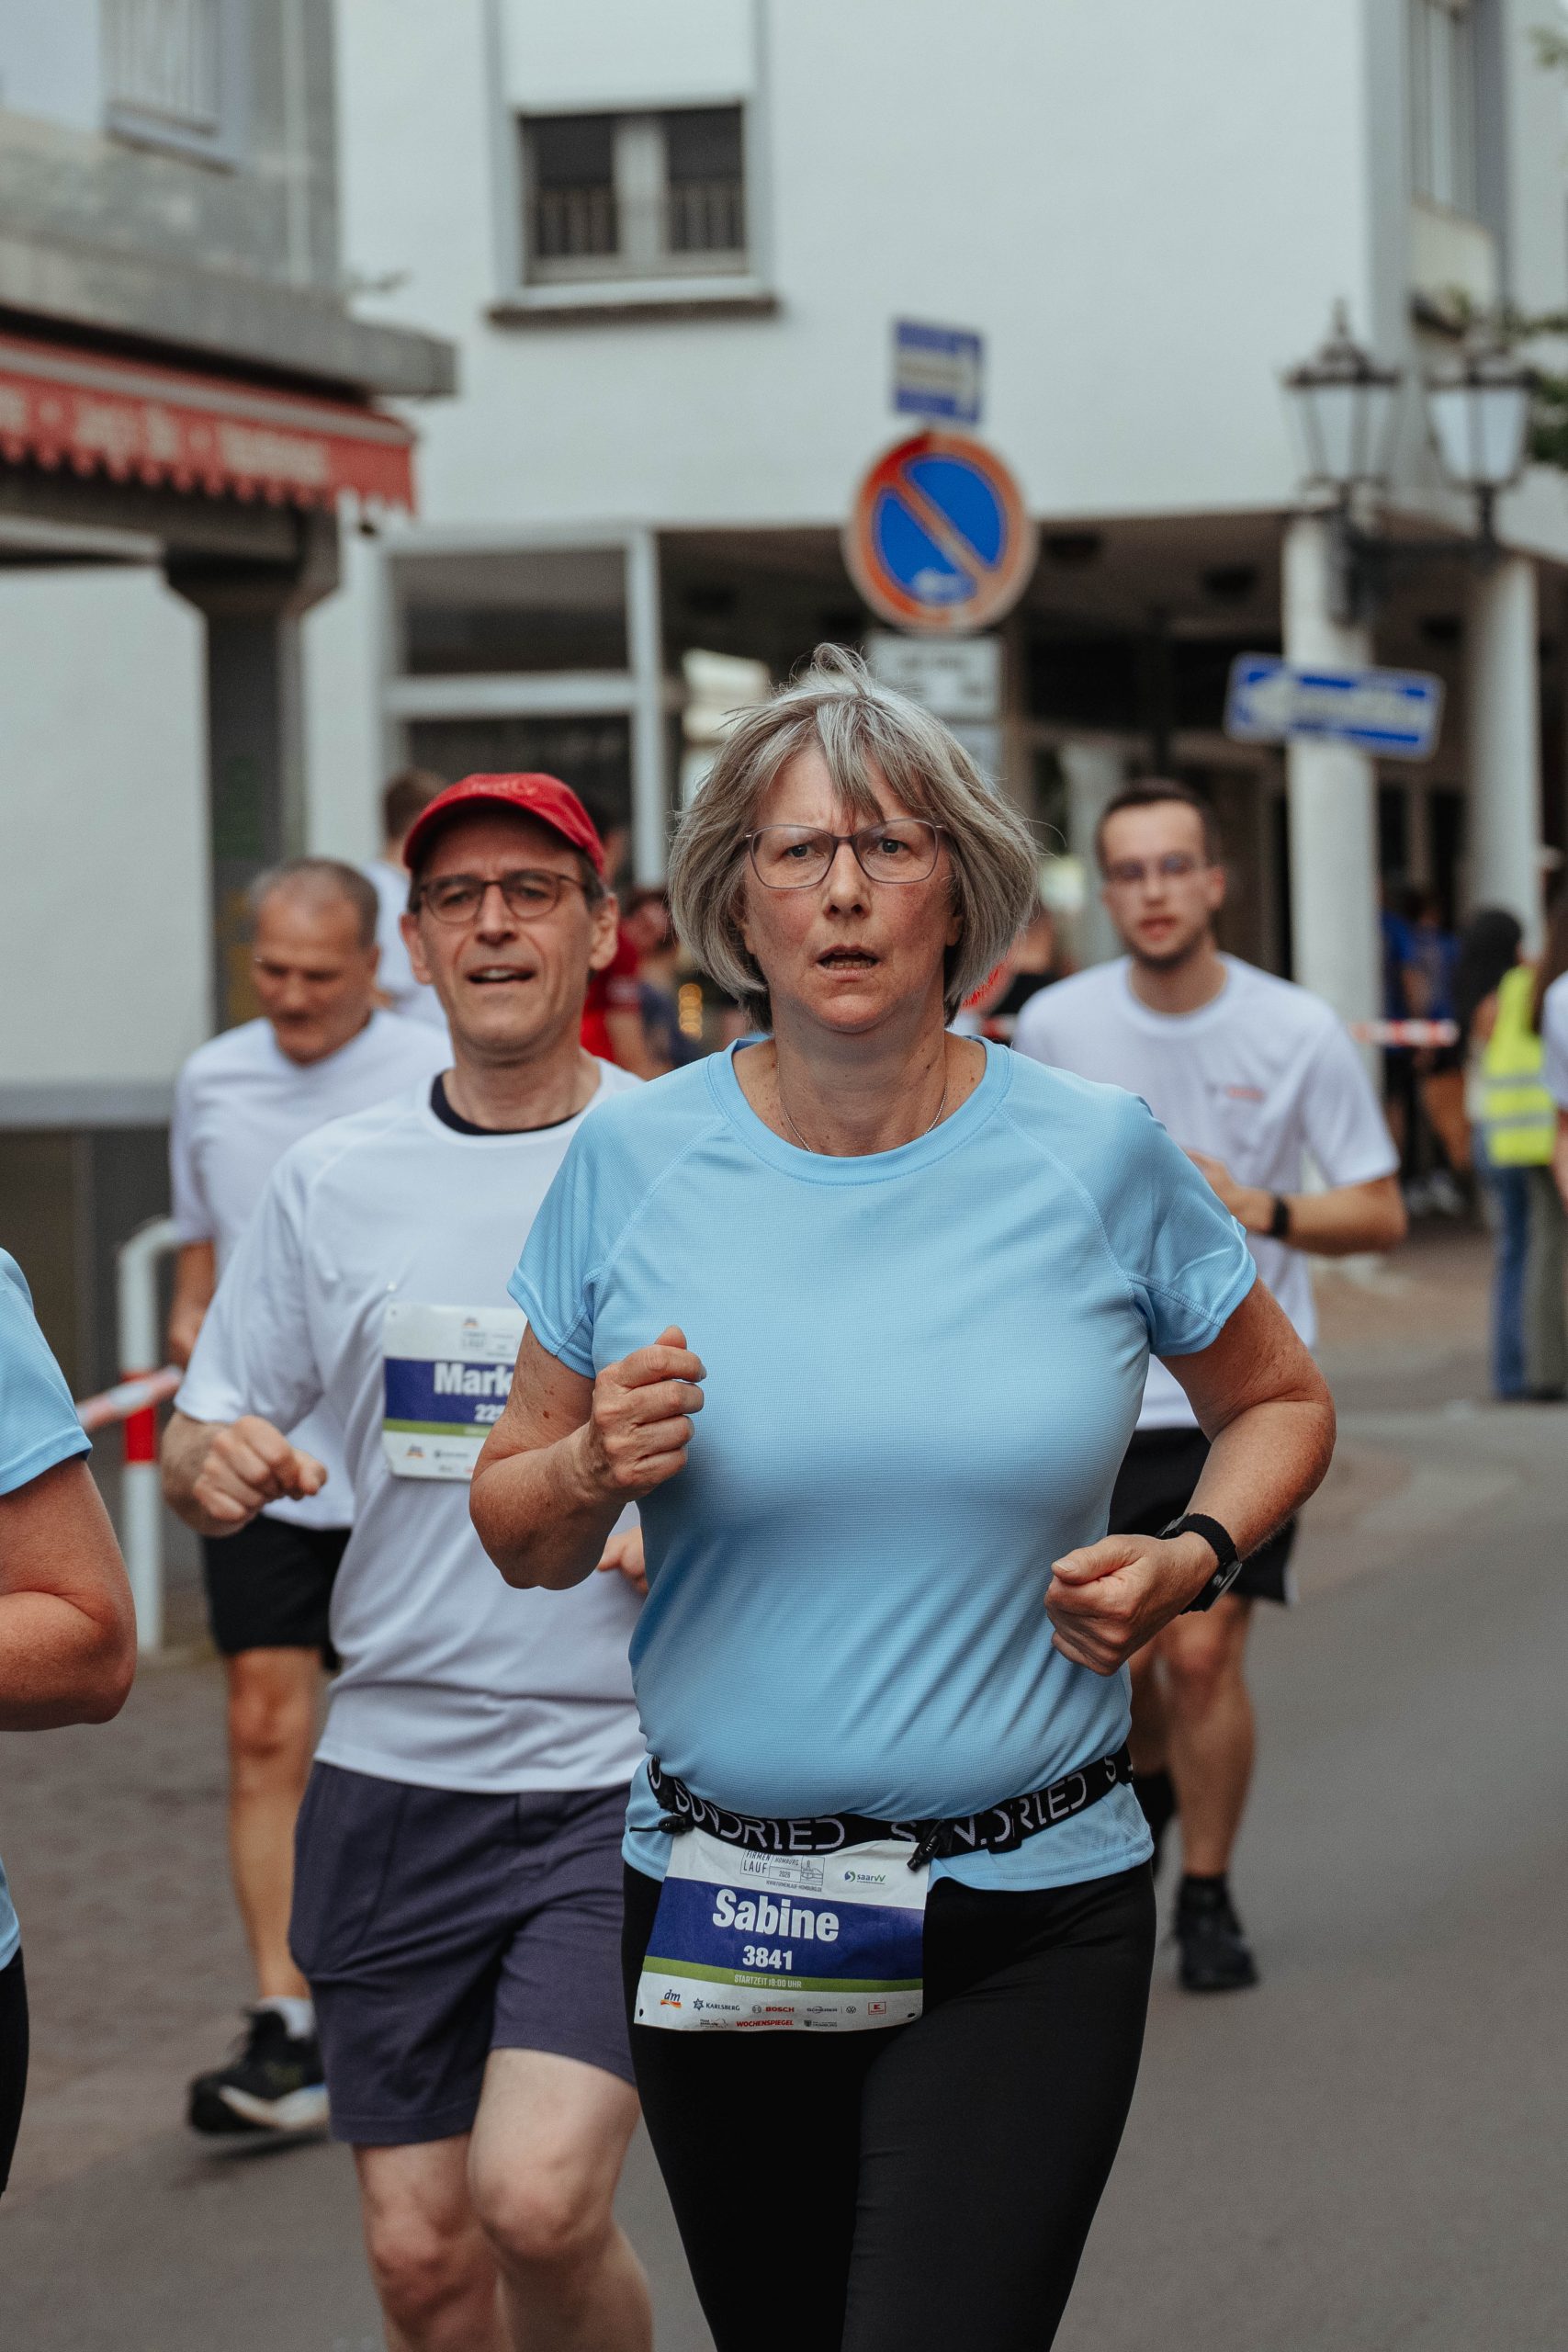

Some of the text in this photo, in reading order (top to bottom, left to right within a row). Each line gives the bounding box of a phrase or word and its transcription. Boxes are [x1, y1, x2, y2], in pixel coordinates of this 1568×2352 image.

[746, 1850, 772, 1861] FIRMEN
[774, 1857, 800, 1866] HOMBURG
[743, 1861, 768, 1874] LAUF
[712, 1888, 840, 1942] Sabine
[742, 1945, 793, 1971] 3841
[734, 1973, 802, 1988] STARTZEIT 18:00 UHR
[664, 1989, 681, 2002] dm
[705, 2003, 740, 2011] KARLSBERG
